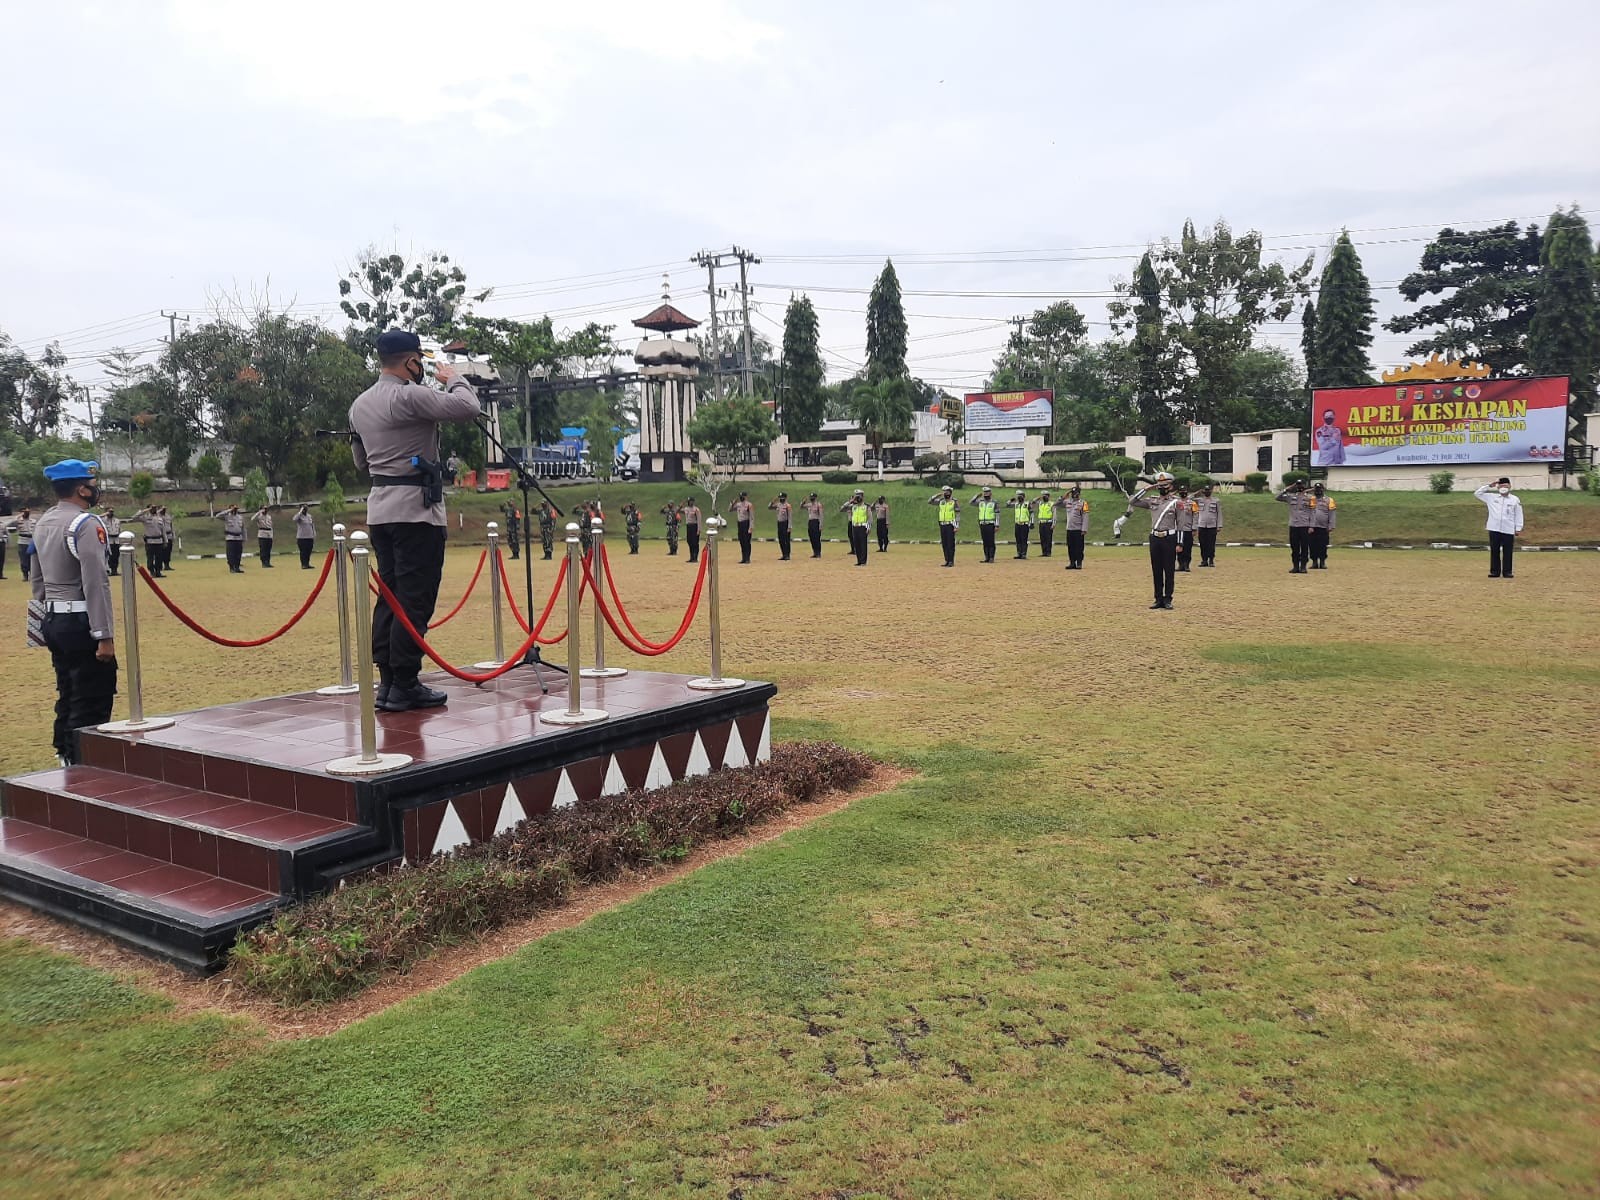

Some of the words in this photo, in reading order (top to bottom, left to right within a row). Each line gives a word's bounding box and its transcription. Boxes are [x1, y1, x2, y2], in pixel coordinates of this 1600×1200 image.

[1347, 405, 1404, 424] APEL
[1411, 399, 1528, 421] KESIAPAN
[1347, 424, 1406, 437] VAKSINASI
[1408, 422, 1466, 434] COVID-19
[1361, 435, 1406, 447] POLRES
[1409, 433, 1466, 446] LAMPUNG
[1469, 431, 1510, 444] UTARA
